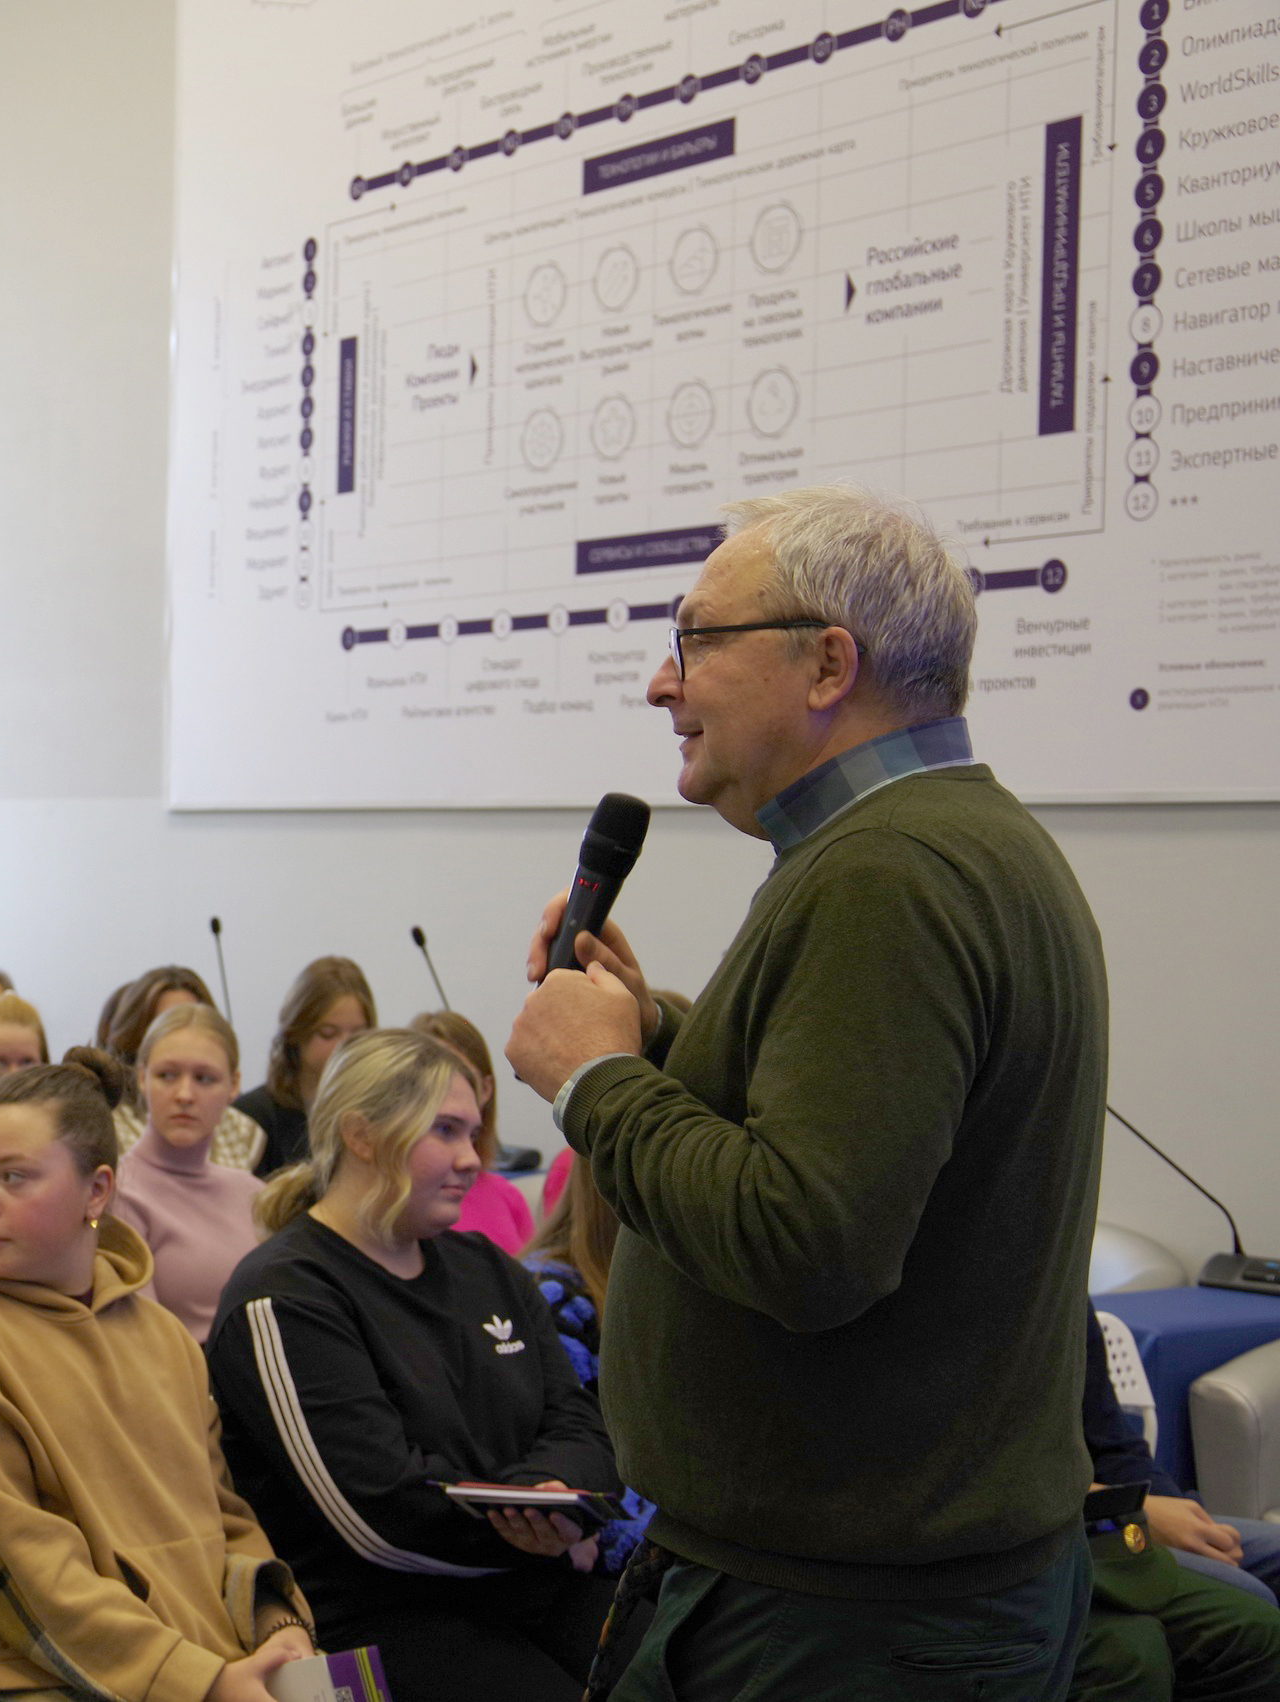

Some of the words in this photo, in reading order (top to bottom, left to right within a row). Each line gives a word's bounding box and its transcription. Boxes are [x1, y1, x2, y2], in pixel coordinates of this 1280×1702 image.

[1180, 62, 1280, 102] WorldSkills
[1179, 112, 1280, 151] Кружковое
[1051, 142, 1071, 311] ПРЕДПРИНИМАТЕЛИ
[1175, 216, 1242, 243] Школы
[866, 233, 960, 267] Российские
[866, 263, 963, 295] глобальные
[1175, 261, 1251, 289] Сетевые
[866, 297, 943, 325] компании
[1173, 301, 1271, 333] Навигатор
[1050, 331, 1066, 409] ТАЛАНТЫ
[1136, 407, 1154, 425] 10
[1136, 449, 1151, 467] 11
[1170, 443, 1279, 472] Экспертные
[1133, 493, 1150, 511] 12
[1045, 567, 1064, 585] 12
[1015, 617, 1091, 636] Венчурные
[1014, 643, 1092, 659] инвестиции
[978, 676, 1037, 693] проектов
